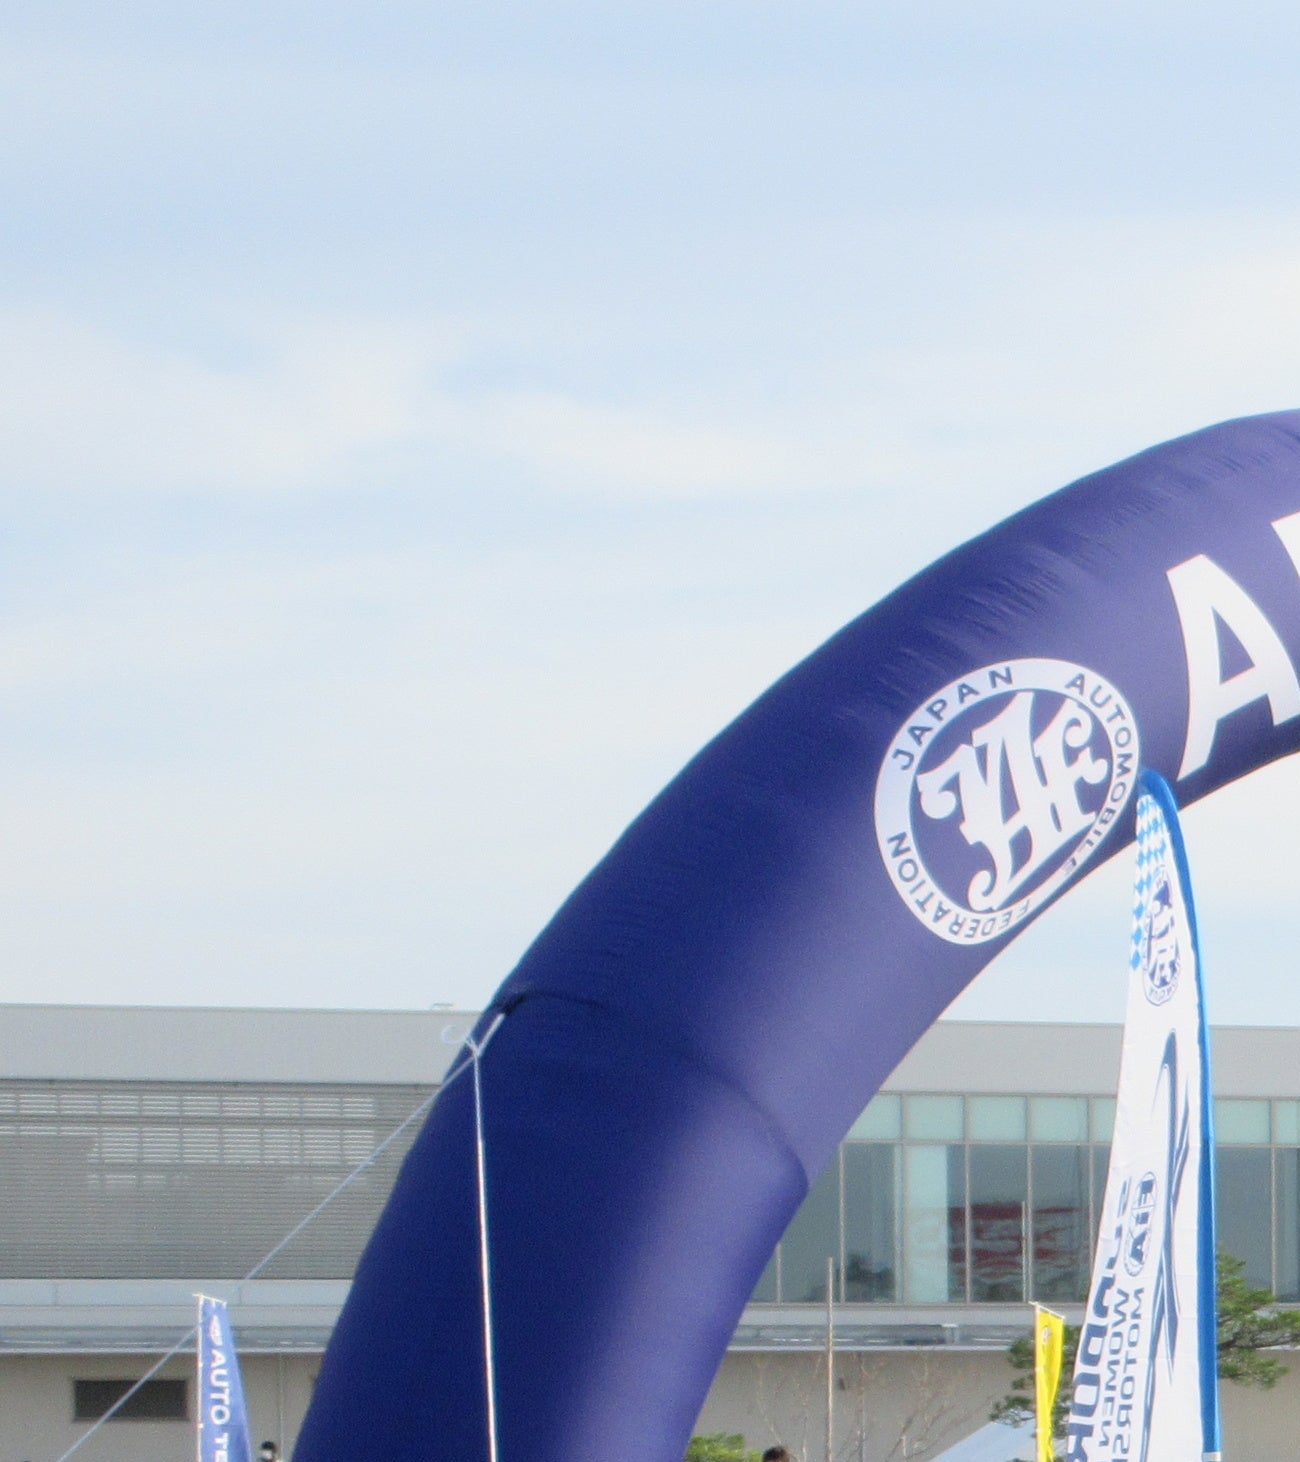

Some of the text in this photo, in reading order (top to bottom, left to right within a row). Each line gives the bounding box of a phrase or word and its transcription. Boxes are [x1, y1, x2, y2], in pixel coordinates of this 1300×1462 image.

[890, 665, 1136, 877] JAPAN AUTOMOBILE
[886, 831, 1030, 940] FEDERATION
[210, 1350, 230, 1425] AUTO
